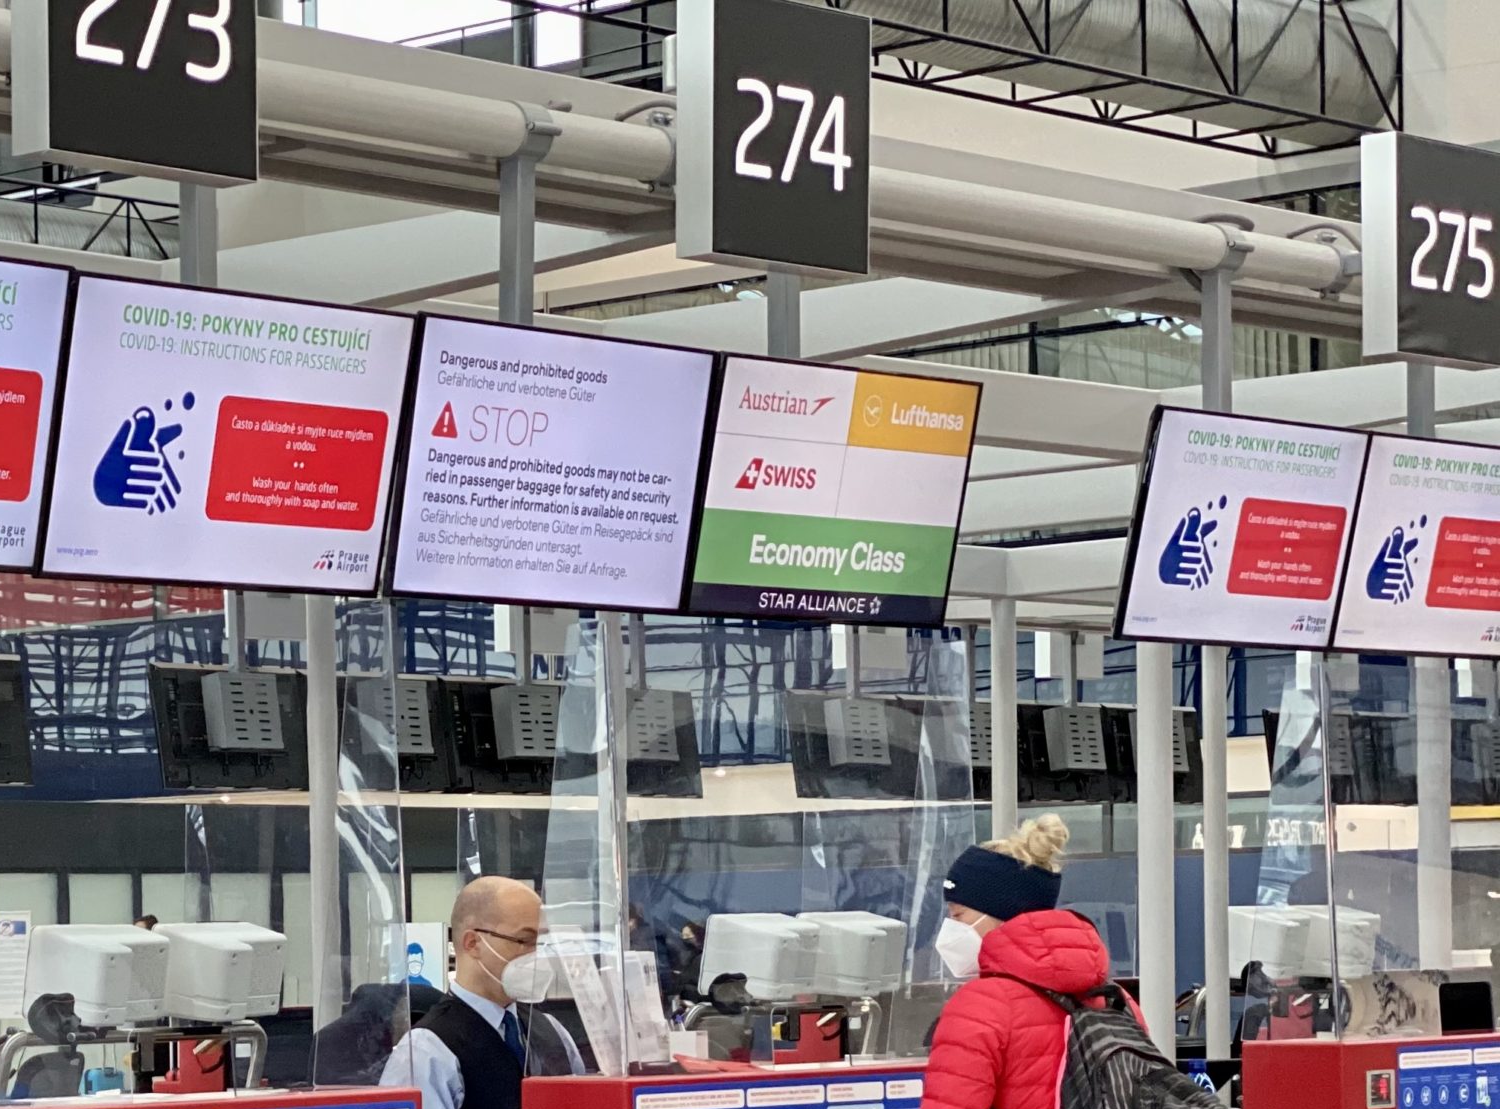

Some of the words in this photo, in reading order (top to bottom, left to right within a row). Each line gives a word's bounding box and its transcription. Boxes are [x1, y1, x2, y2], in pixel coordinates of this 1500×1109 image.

[735, 78, 852, 192] 274
[1411, 206, 1494, 299] 275
[122, 303, 196, 331] COVID-19:
[200, 313, 264, 338] POKYNY
[267, 321, 298, 342] PRO
[302, 325, 371, 351] CESTUJÍCÍ
[119, 331, 176, 353] COVID-19:
[180, 338, 267, 364] INSTRUCTIONS
[268, 348, 292, 367] FOR
[294, 351, 367, 374] PASSENGERS
[439, 349, 498, 370] Dangerous
[499, 359, 520, 373] and
[520, 362, 575, 380] prohibited
[575, 370, 607, 384] goods
[437, 370, 495, 391] Gefährliche
[496, 379, 517, 393] und
[517, 381, 567, 399] verbotene
[568, 385, 596, 402] Güter
[738, 385, 809, 416] Austrian
[468, 404, 549, 447] STOP
[891, 402, 965, 431] Lufthansa
[427, 447, 486, 467] Dangerous
[487, 455, 508, 469] and
[508, 457, 563, 475] prohibited
[563, 463, 595, 478] goods
[596, 468, 619, 483] may
[619, 469, 636, 482] not
[637, 469, 650, 483] be
[651, 473, 671, 484] car-
[762, 464, 817, 490] SWISS
[424, 468, 447, 483] ried
[447, 470, 458, 484] in
[459, 474, 515, 492] passenger
[515, 476, 561, 497] baggage
[562, 481, 578, 495] for
[578, 484, 610, 501] safety
[610, 487, 630, 500] and
[630, 490, 671, 507] security
[419, 507, 478, 527] Gefährliche
[479, 514, 499, 528] und
[500, 515, 550, 533] verbotene
[551, 519, 579, 535] Güter
[579, 525, 592, 535] im
[593, 523, 653, 542] Reisegepäck
[653, 529, 674, 543] sind
[422, 491, 467, 505] reasons.
[469, 492, 509, 509] Further
[509, 495, 569, 514] information
[570, 501, 579, 515] is
[580, 504, 624, 519] available
[625, 510, 638, 520] on
[639, 511, 679, 525] request.
[337, 549, 370, 564] Prague
[417, 531, 436, 543] aus
[437, 531, 533, 552] Sicherheitsgründen
[535, 540, 582, 558] untersagt.
[749, 534, 848, 576] Economy
[850, 541, 906, 574] Class
[335, 559, 369, 574] Airport
[415, 547, 455, 564] Weitere
[456, 551, 513, 569] Information
[514, 556, 554, 571] erhalten
[555, 559, 571, 573] Sie
[570, 561, 588, 574] auf
[588, 562, 627, 580] Anfrage.
[758, 592, 795, 610] STAR
[797, 595, 866, 614] ALLIANCE
